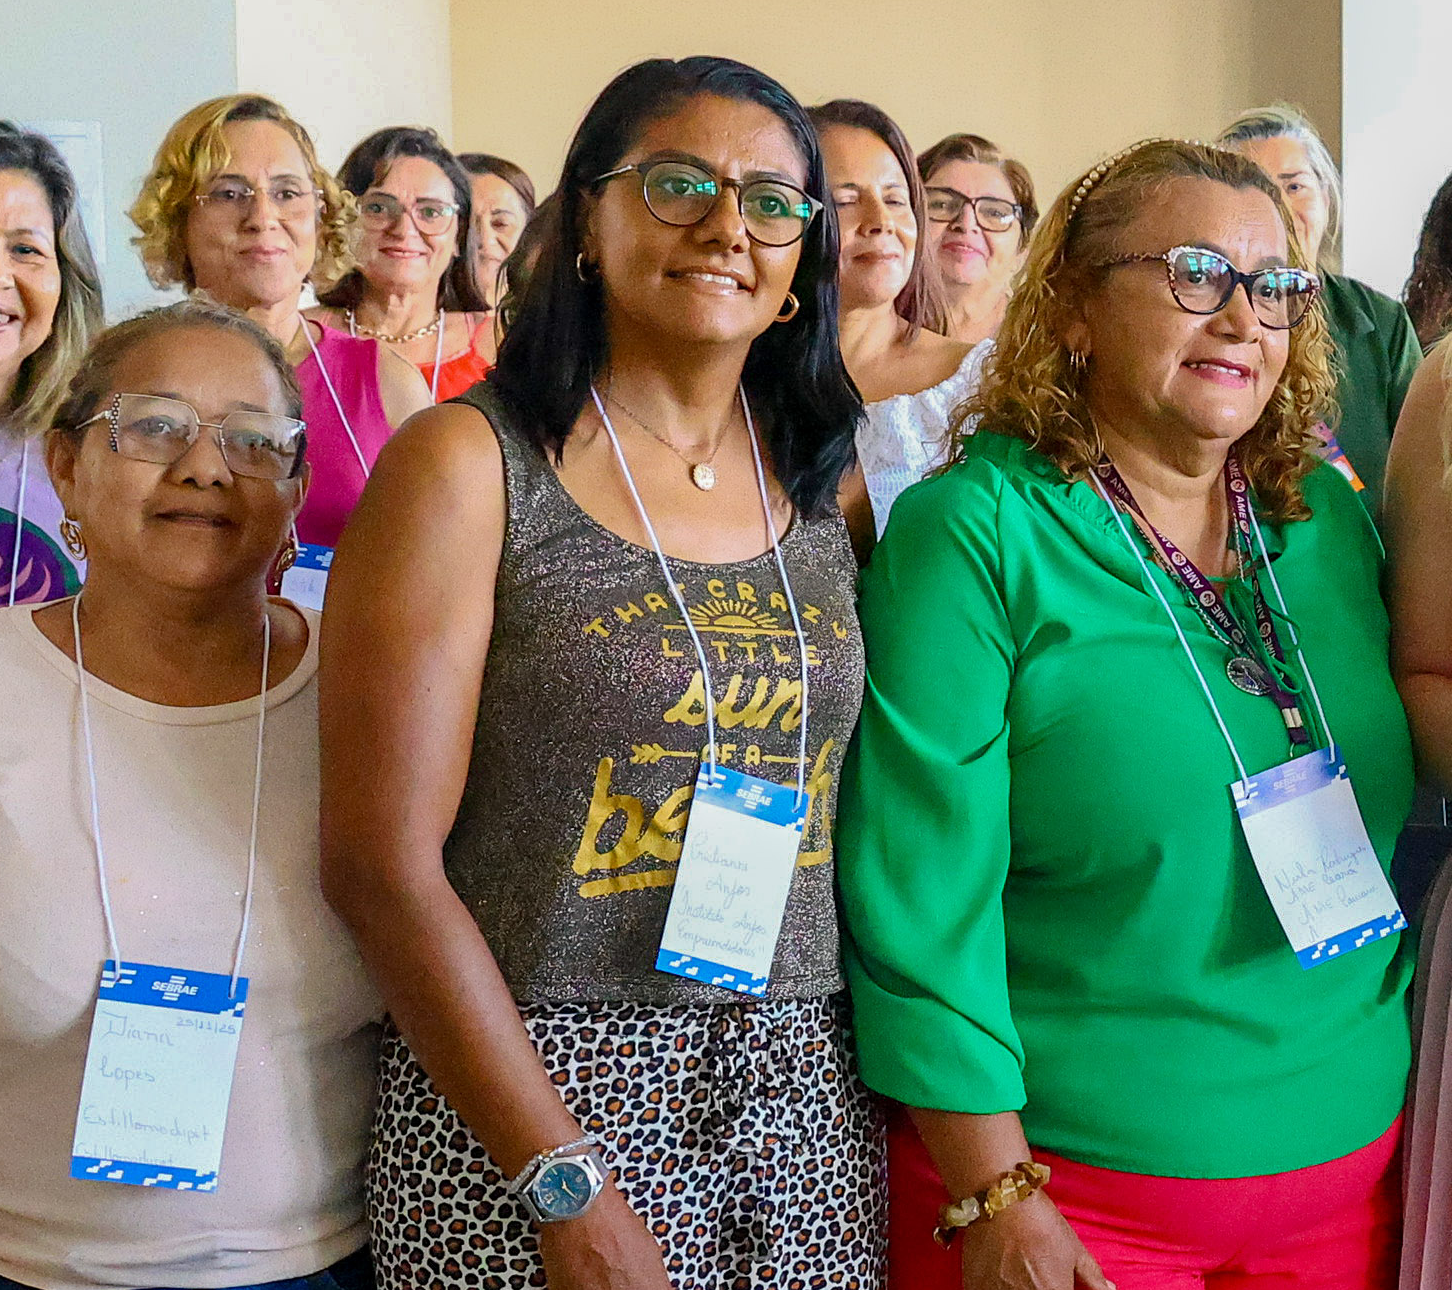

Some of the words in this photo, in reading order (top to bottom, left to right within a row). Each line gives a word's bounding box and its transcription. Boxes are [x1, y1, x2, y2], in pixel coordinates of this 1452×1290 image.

[1235, 495, 1247, 519] AME
[1181, 565, 1204, 589] AME
[1211, 604, 1232, 628] AME
[662, 638, 823, 666] LTTLE
[663, 669, 806, 732] sun
[701, 743, 737, 764] OF
[745, 743, 761, 765] A
[735, 788, 773, 807] SEBRAE
[151, 981, 199, 996] SEBRAE
[99, 1056, 156, 1091] Lopes
